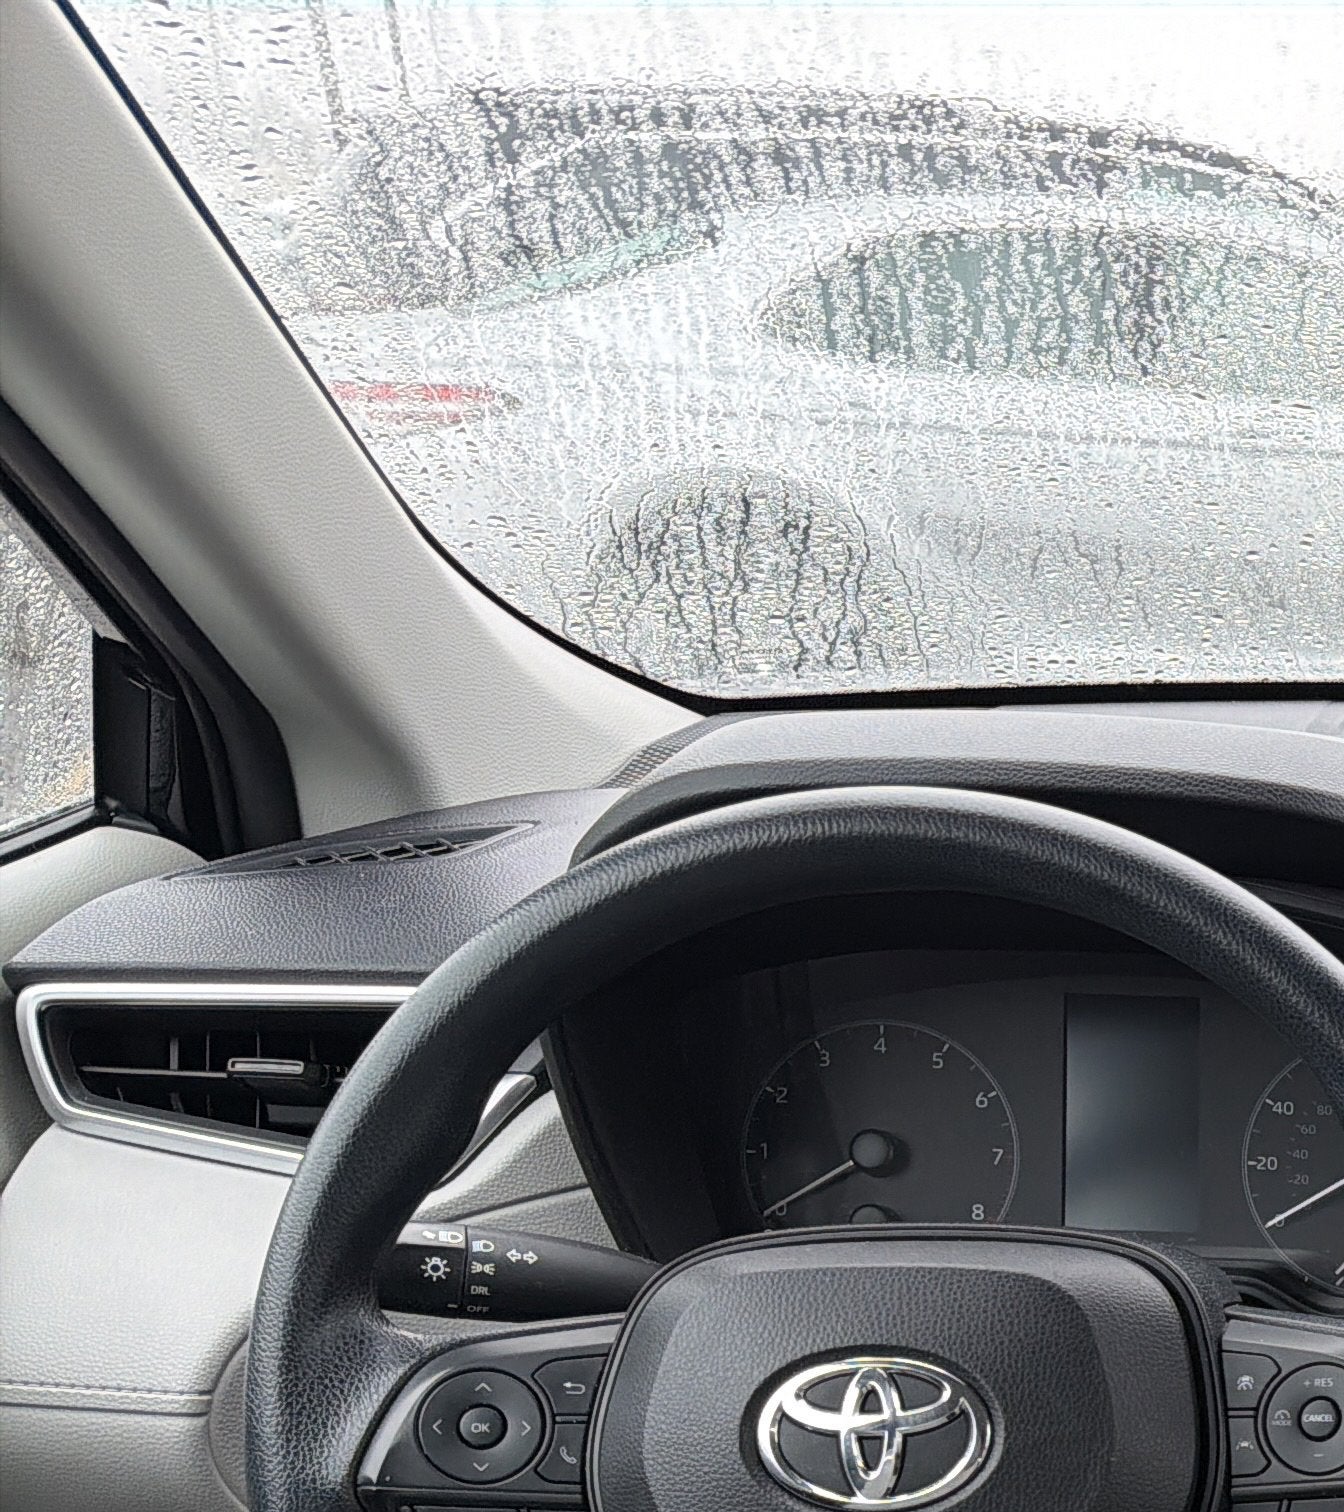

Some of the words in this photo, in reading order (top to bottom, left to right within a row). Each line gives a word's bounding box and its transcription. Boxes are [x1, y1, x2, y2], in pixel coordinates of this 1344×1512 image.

[873, 1037, 887, 1054] 4
[819, 1050, 831, 1067] 3
[932, 1053, 944, 1069] 5
[775, 1087, 788, 1104] 2
[975, 1092, 988, 1108] 6
[1272, 1101, 1294, 1116] 40
[1316, 1105, 1333, 1116] 80
[1300, 1124, 1317, 1135] 60
[760, 1142, 769, 1160] 1
[992, 1148, 1004, 1165] 7
[1292, 1149, 1309, 1160] 40
[1256, 1157, 1278, 1171] 20
[1293, 1174, 1309, 1185] 20
[971, 1204, 985, 1221] 8
[470, 1285, 490, 1295] DRL
[467, 1305, 490, 1313] OFF
[1313, 1378, 1334, 1388] RES
[1303, 1413, 1335, 1423] CANCEL
[471, 1422, 490, 1433] OK
